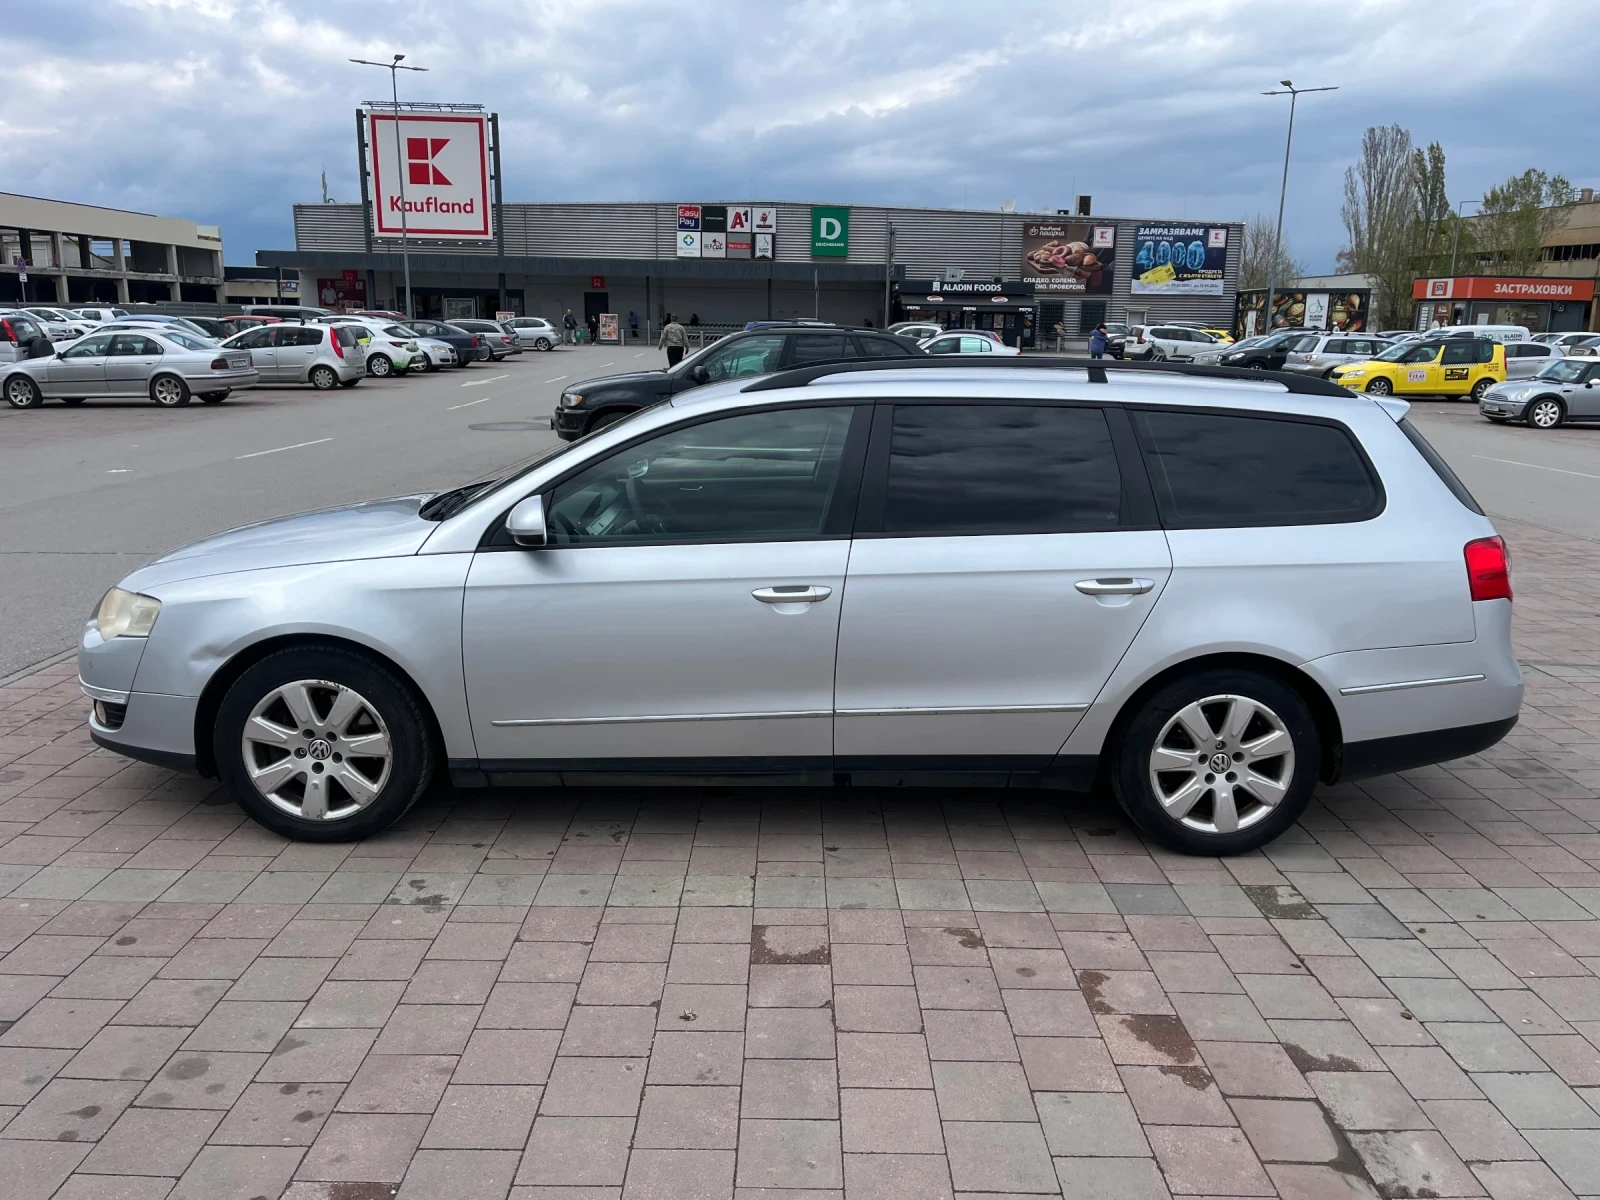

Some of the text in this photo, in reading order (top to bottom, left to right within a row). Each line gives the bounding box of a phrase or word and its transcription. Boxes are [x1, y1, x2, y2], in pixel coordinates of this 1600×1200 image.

[389, 195, 474, 214] Kaufland
[679, 208, 699, 219] Easy
[679, 217, 695, 227] Pay
[730, 210, 749, 229] A1
[1138, 227, 1205, 236] ЗАМРАЗЯВАМЕ
[1136, 240, 1206, 270] 4000
[973, 284, 1002, 292] FOODS
[1494, 283, 1573, 295] ЗАСТРАХОВКИ
